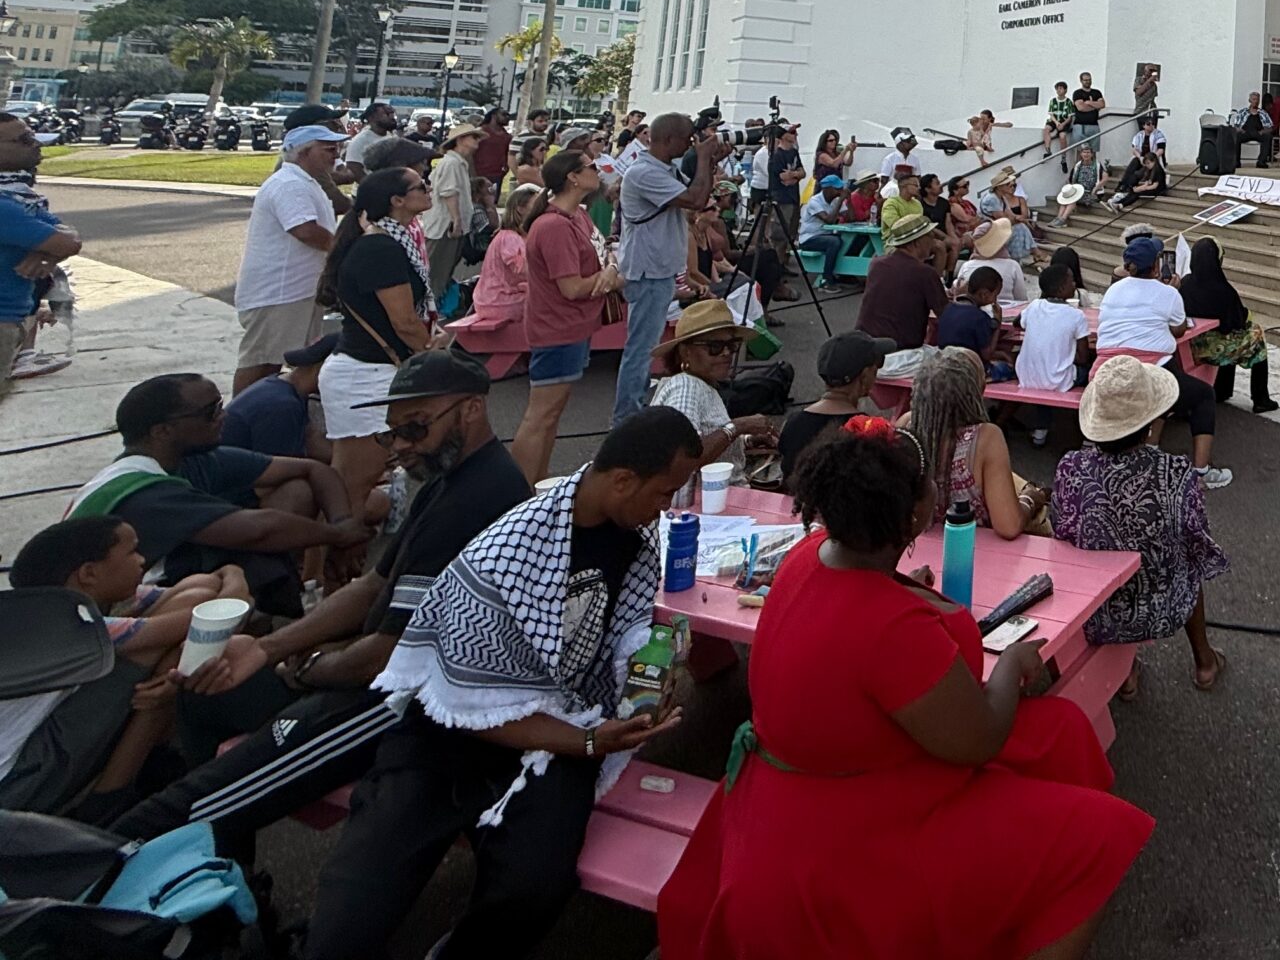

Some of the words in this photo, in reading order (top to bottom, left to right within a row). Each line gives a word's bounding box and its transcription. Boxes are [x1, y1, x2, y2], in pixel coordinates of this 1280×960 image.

[998, 2, 1012, 13] EARL
[1001, 16, 1041, 30] CORPORATION
[1042, 13, 1064, 25] OFFICE
[1225, 176, 1274, 194] END
